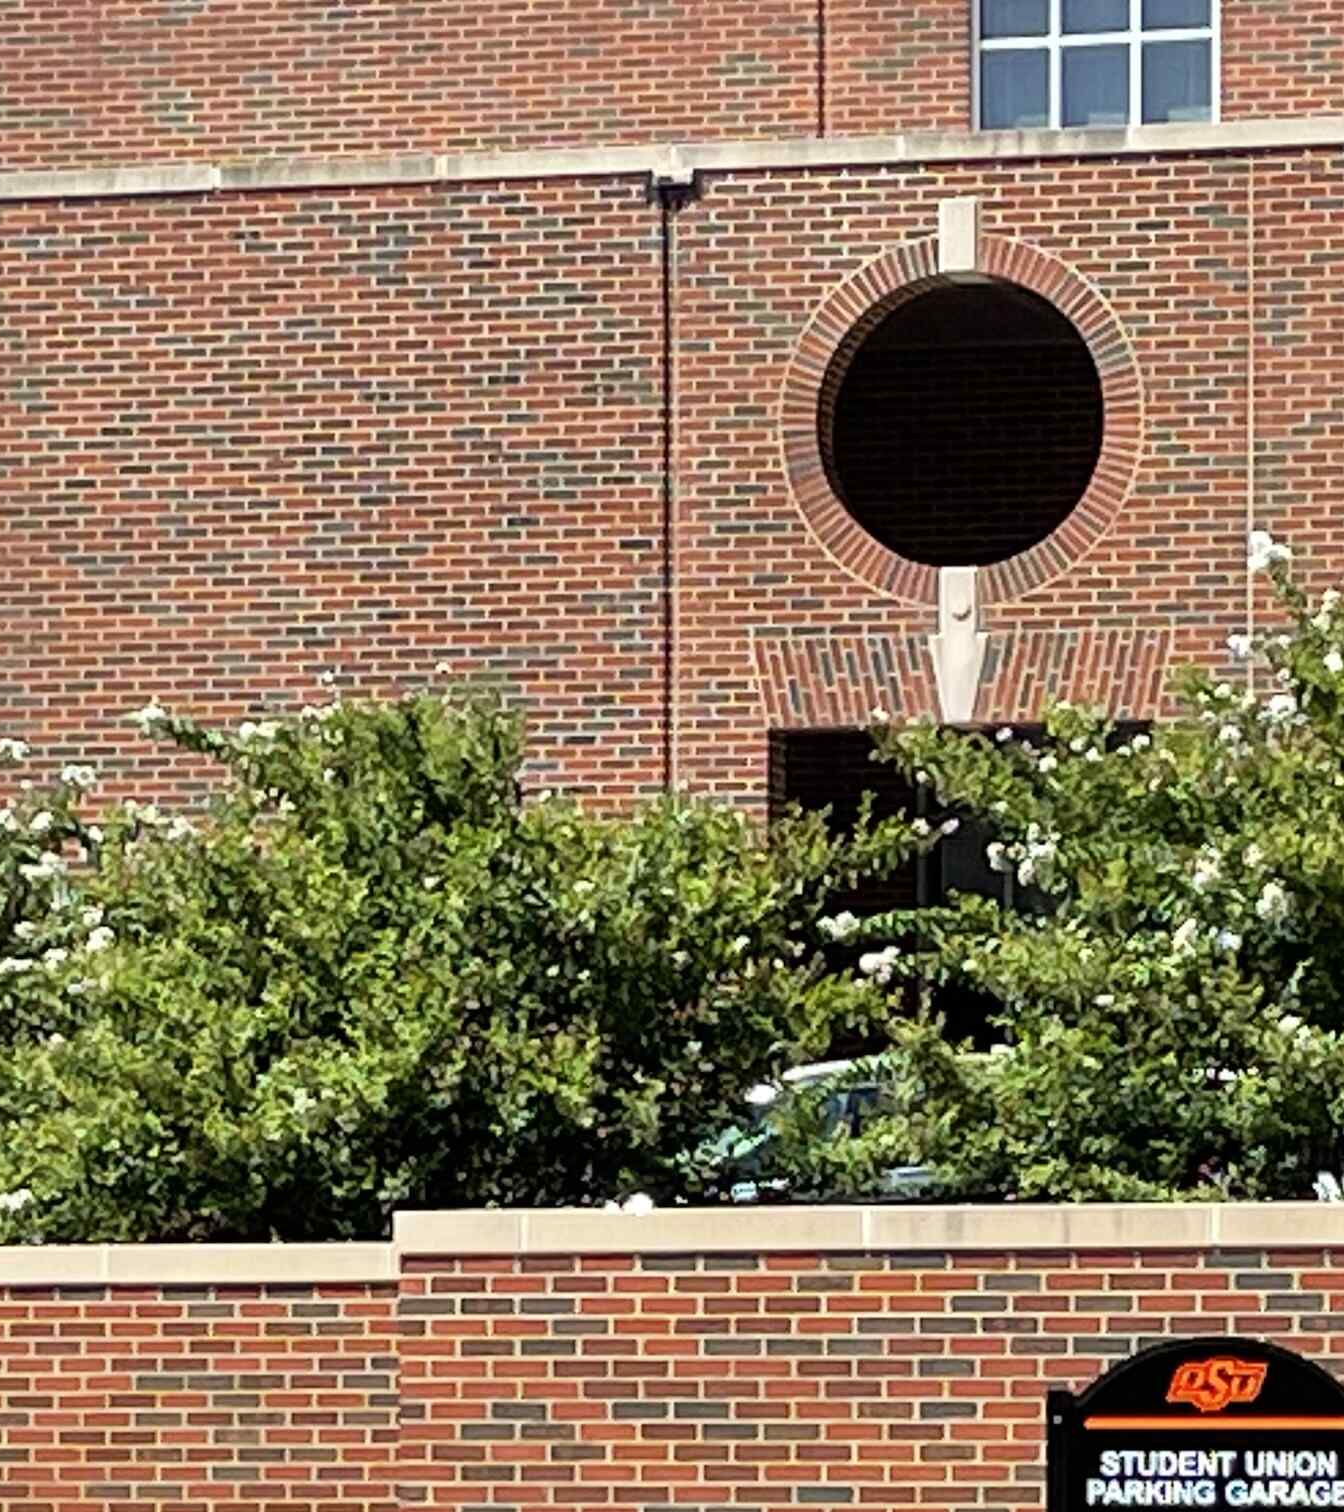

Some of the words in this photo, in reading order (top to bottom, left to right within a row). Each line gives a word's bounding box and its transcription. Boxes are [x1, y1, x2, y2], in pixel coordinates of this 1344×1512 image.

[1167, 1357, 1267, 1412] OSU
[1099, 1450, 1236, 1477] STUDENT
[1244, 1450, 1338, 1477] UNION
[1085, 1479, 1215, 1507] PARKING
